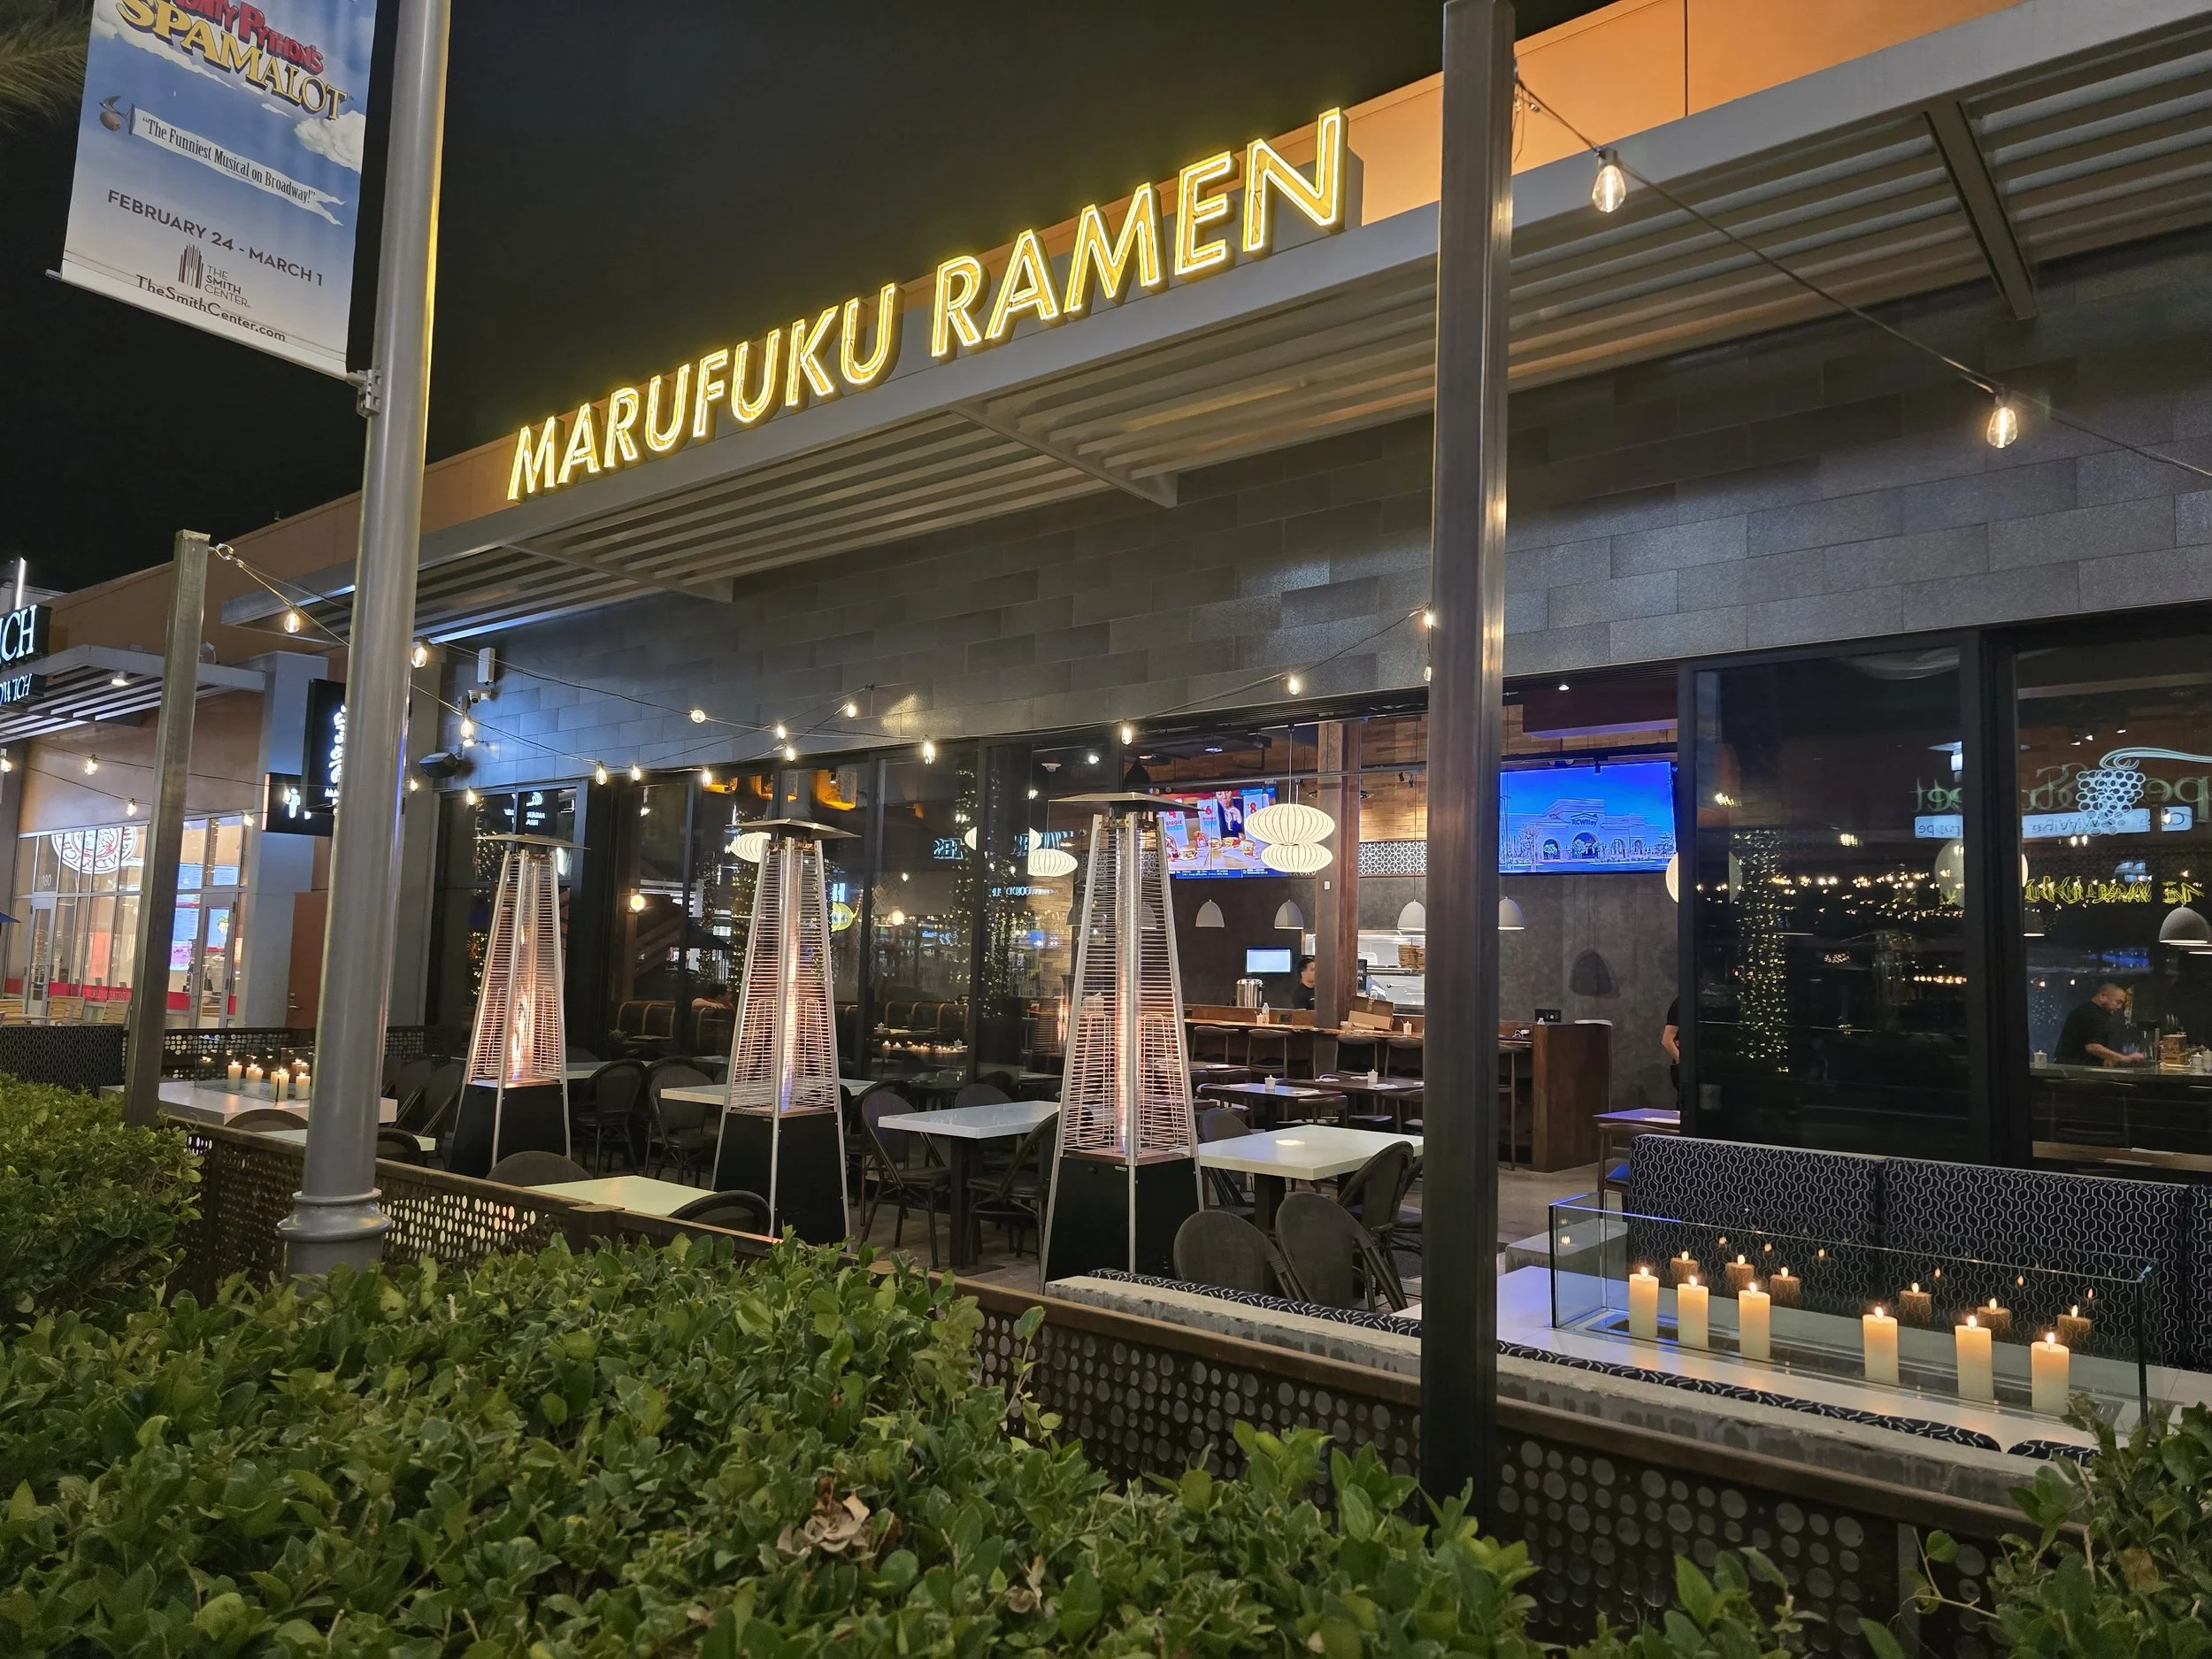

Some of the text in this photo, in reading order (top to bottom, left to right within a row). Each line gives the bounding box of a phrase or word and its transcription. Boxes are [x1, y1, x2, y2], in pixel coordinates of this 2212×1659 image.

[116, 0, 348, 121] SPAMALOT
[169, 128, 212, 160] Funniest
[214, 148, 250, 178] Musical
[251, 168, 263, 183] on
[107, 189, 207, 239] FEBRUARY
[211, 232, 234, 251] 24
[249, 247, 312, 281] MARCH
[317, 273, 323, 286] 1
[206, 274, 242, 295] SMITH
[207, 265, 229, 280] THE
[507, 107, 1340, 501] MARUFUKU RAMEN
[136, 274, 286, 342] TheSmithCenter.com
[0, 603, 37, 663] CH
